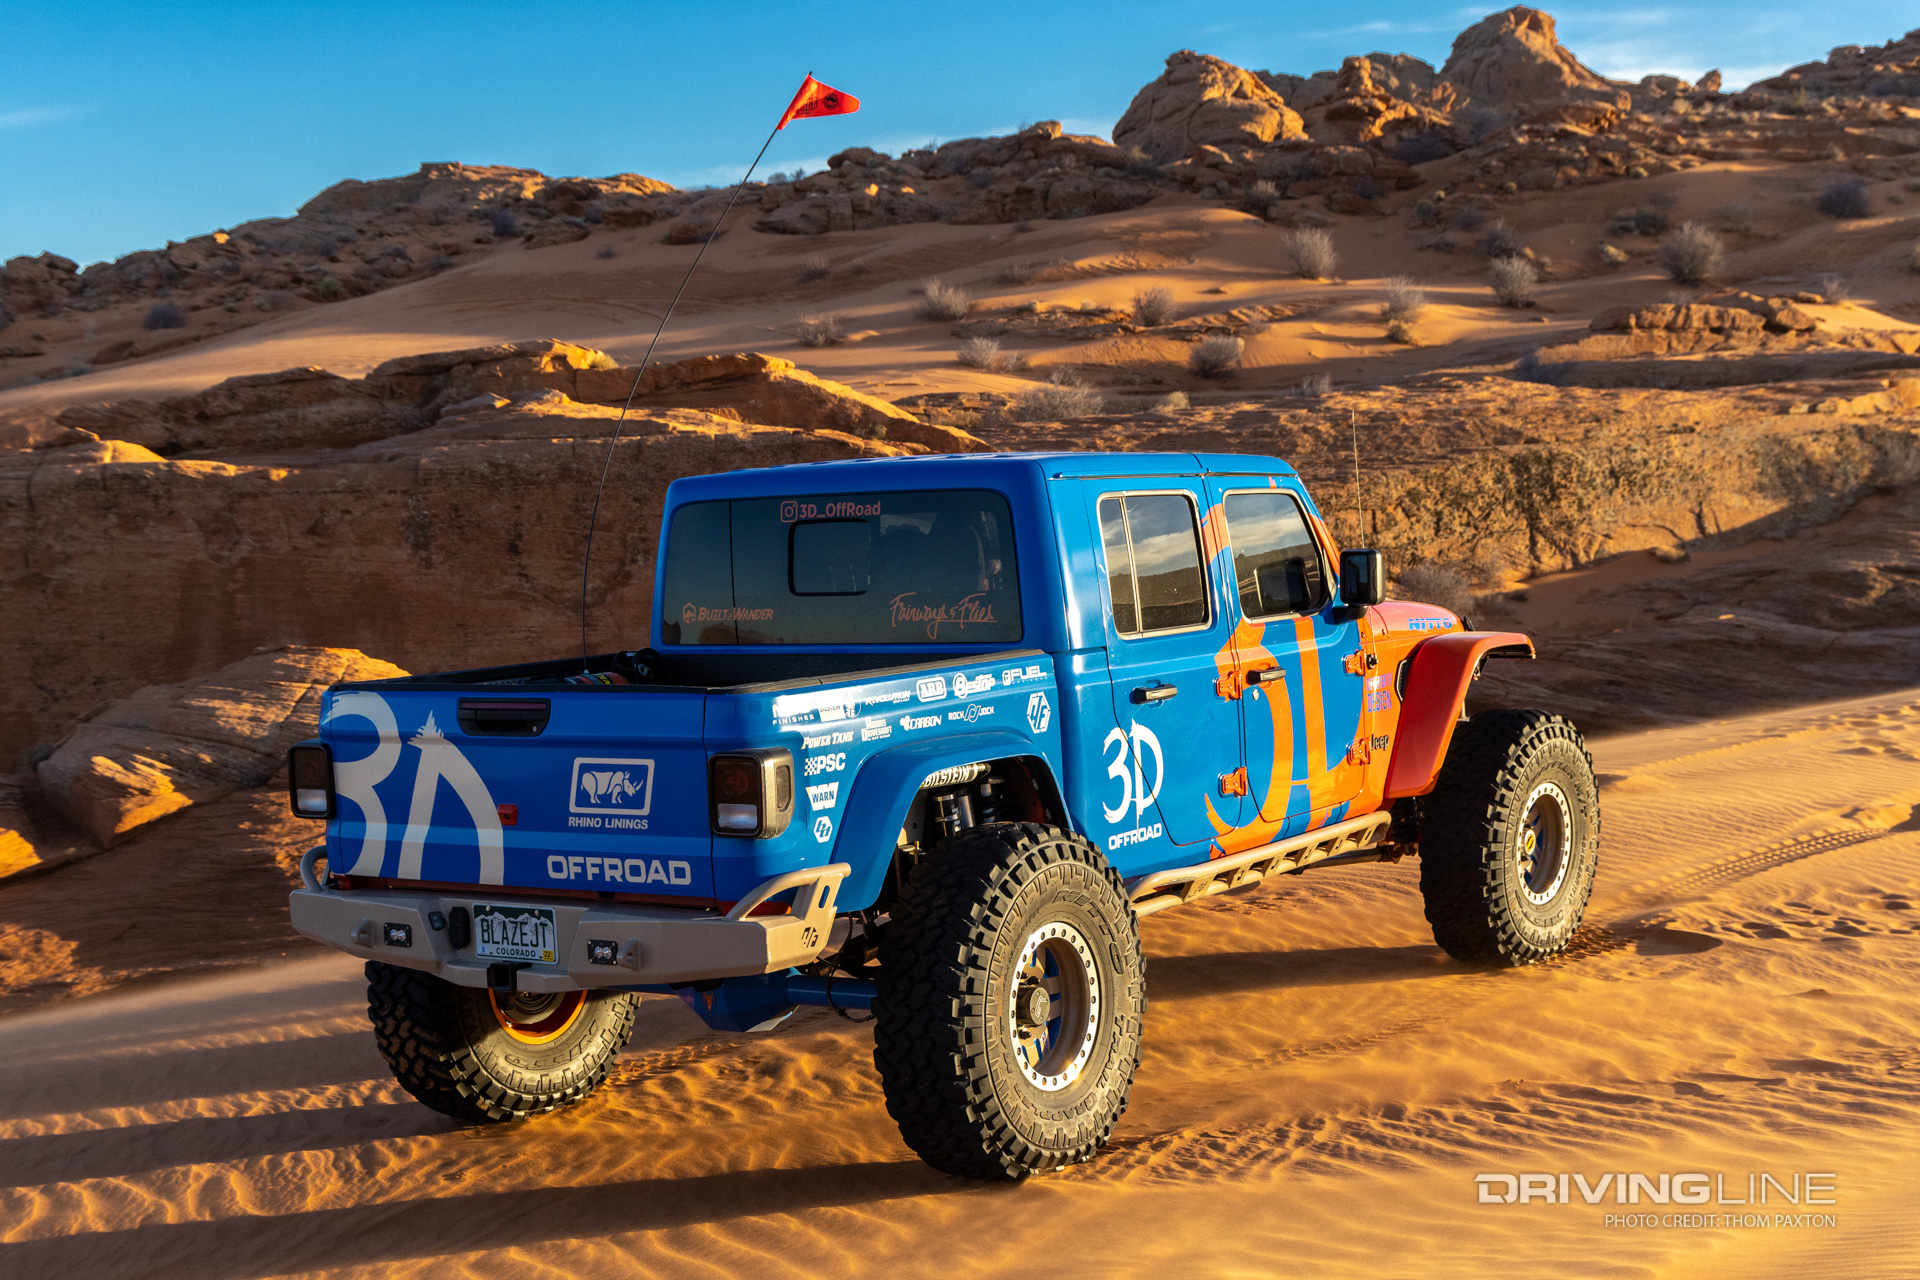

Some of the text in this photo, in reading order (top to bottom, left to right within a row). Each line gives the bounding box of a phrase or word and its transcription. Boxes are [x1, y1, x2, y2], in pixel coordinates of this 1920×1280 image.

[959, 592, 997, 629] Flies
[1408, 618, 1452, 631] NITTO
[1011, 665, 1047, 681] FUEL
[920, 681, 944, 698] ARB
[1367, 690, 1392, 713] DESIGN
[801, 735, 831, 750] POWER
[1371, 734, 1389, 751] Jeep
[816, 752, 846, 775] PSC
[923, 766, 970, 788] BILSTEIN
[812, 790, 835, 804] WARN
[568, 816, 649, 830] RHINO LININGS
[1108, 823, 1162, 851] OFFROAD
[546, 855, 692, 886] OFFROAD
[480, 918, 548, 948] BLAZEJT
[1052, 889, 1124, 975] NITTO
[495, 947, 536, 958] COLORADO
[1096, 1014, 1125, 1089] TRAIL
